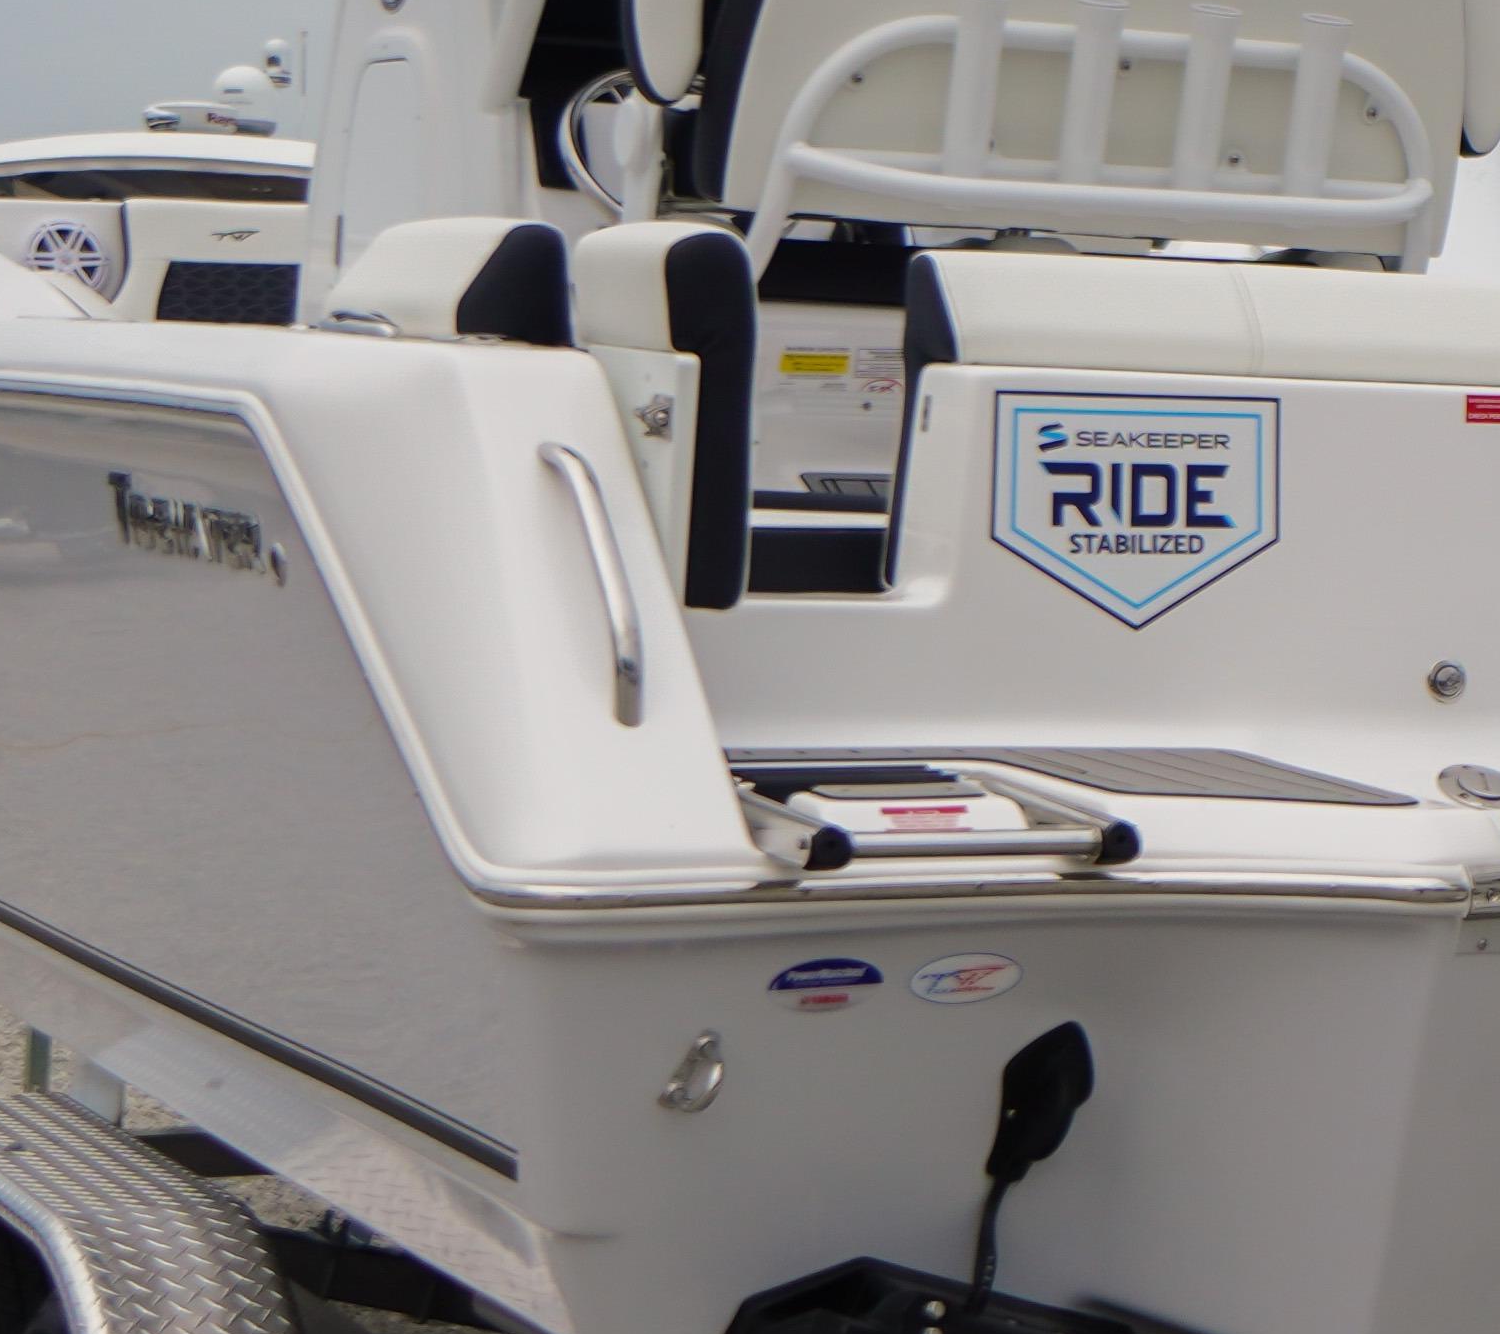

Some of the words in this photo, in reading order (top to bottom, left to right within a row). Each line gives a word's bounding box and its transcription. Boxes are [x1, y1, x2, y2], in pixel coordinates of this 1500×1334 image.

[1076, 431, 1230, 449] SEAKEEPER
[1039, 462, 1236, 527] RIDE
[1069, 534, 1205, 554] STABILIZED
